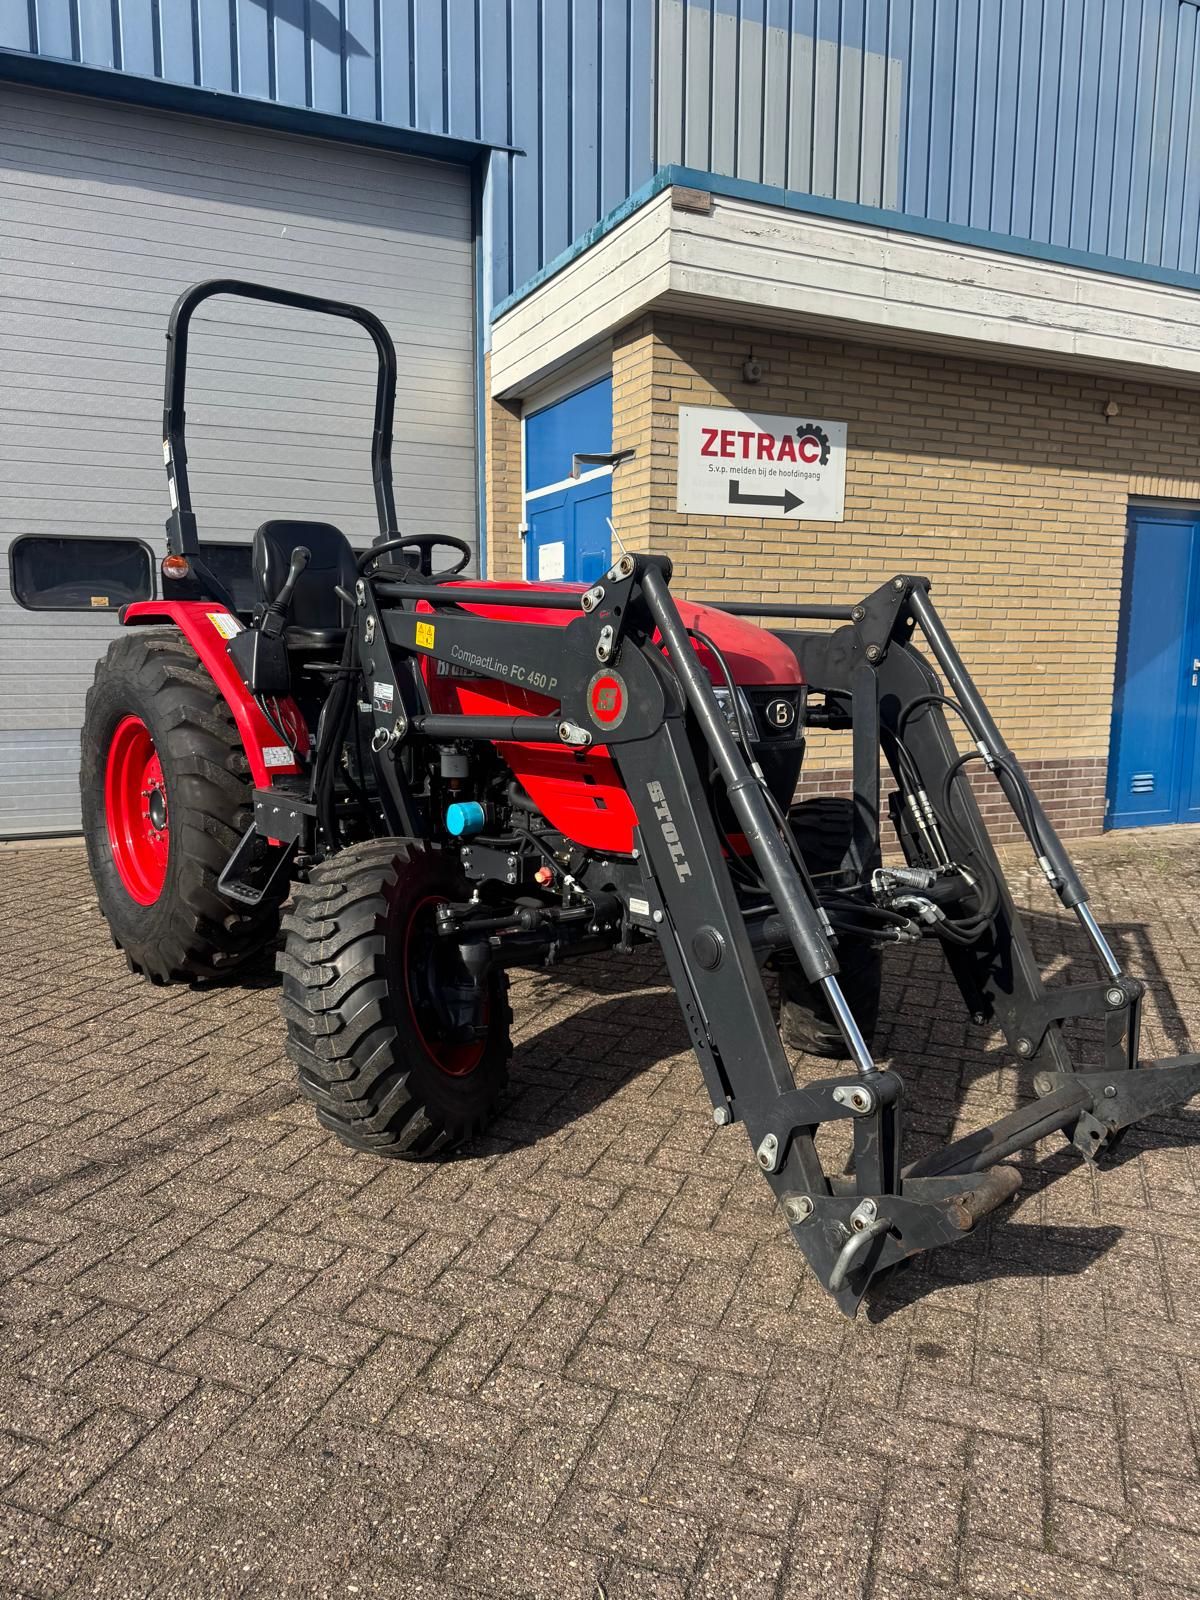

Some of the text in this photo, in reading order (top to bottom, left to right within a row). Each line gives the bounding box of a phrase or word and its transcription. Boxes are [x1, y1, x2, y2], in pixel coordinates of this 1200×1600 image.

[701, 428, 820, 463] ZETRAC
[708, 464, 821, 481] S.v.p. melden bij de hoofdingang
[451, 644, 508, 676] CompactLine
[510, 664, 525, 681] FC
[527, 671, 547, 688] 450
[549, 677, 557, 691] P
[646, 780, 692, 883] STOLL
